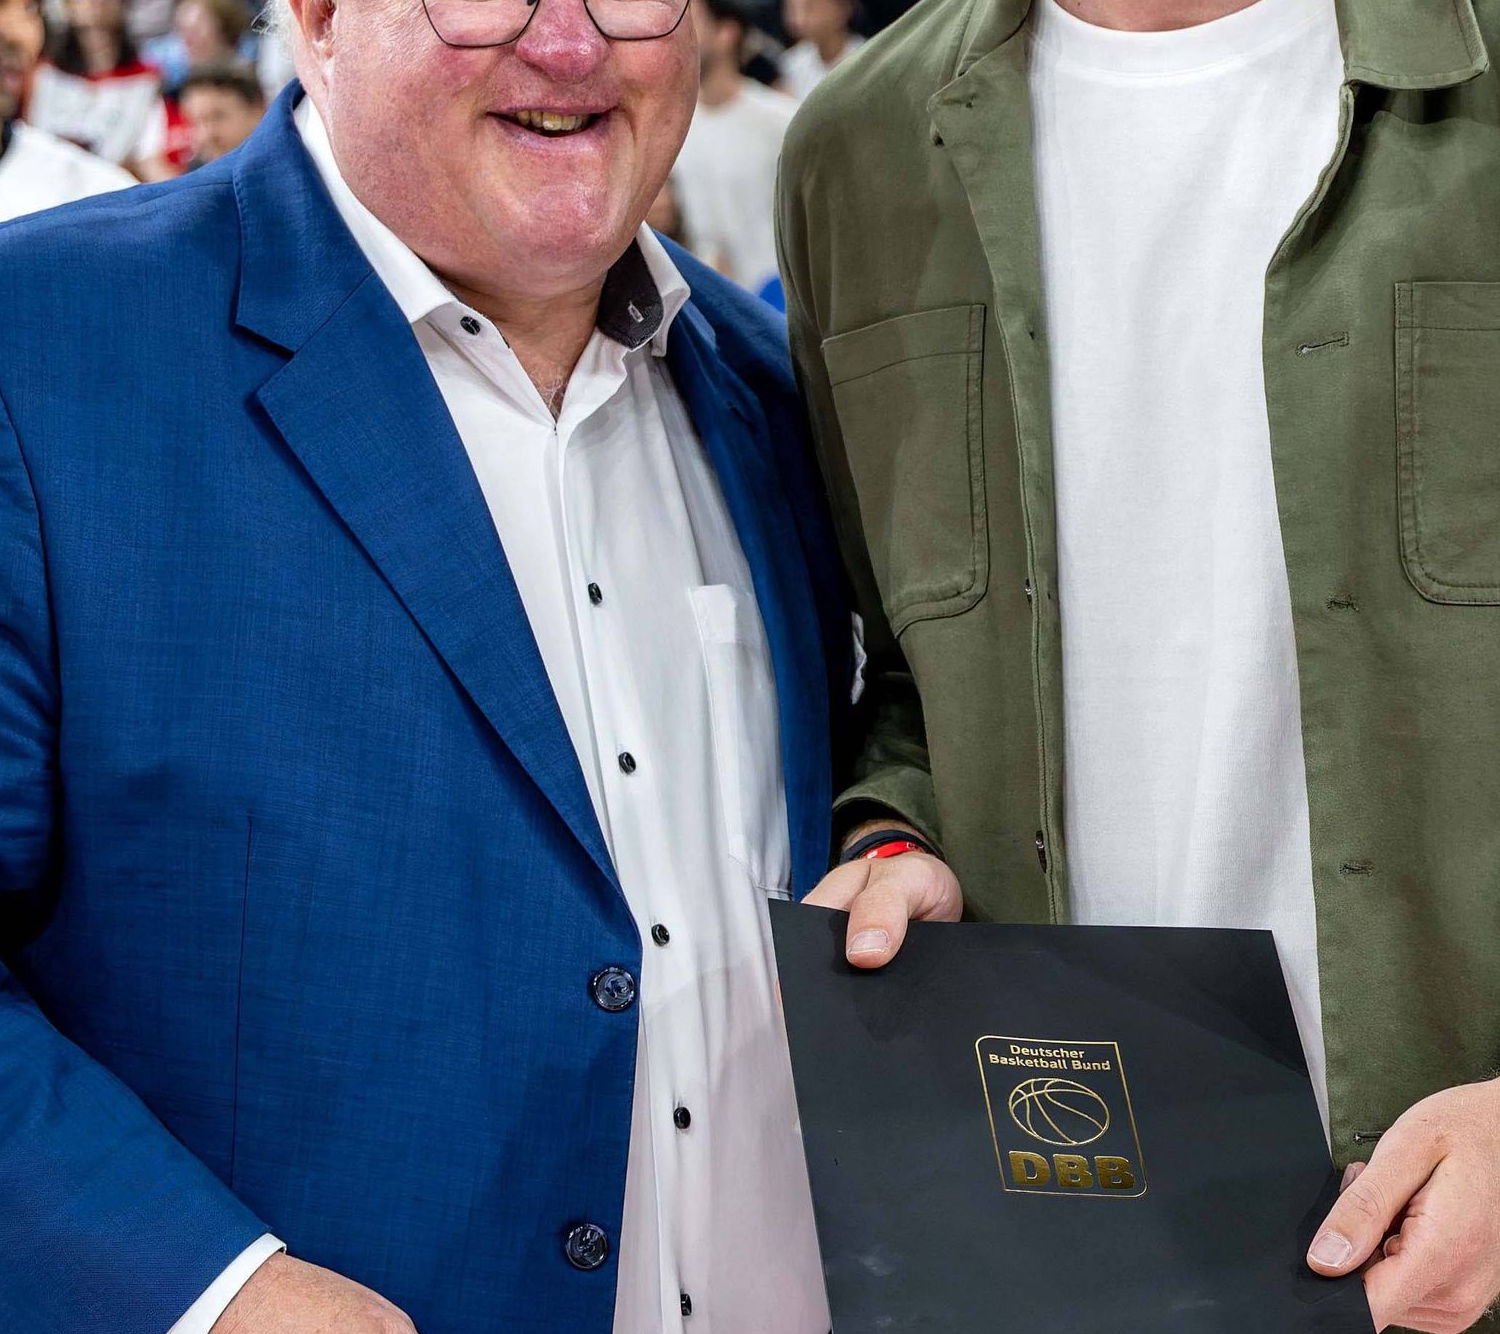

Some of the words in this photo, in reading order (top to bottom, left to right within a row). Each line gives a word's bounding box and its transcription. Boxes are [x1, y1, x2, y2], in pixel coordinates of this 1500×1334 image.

[1009, 1044, 1085, 1059] Deutscher
[988, 1053, 1068, 1070] Basketball
[1071, 1059, 1111, 1071] Bund
[1008, 1150, 1136, 1190] DBB
